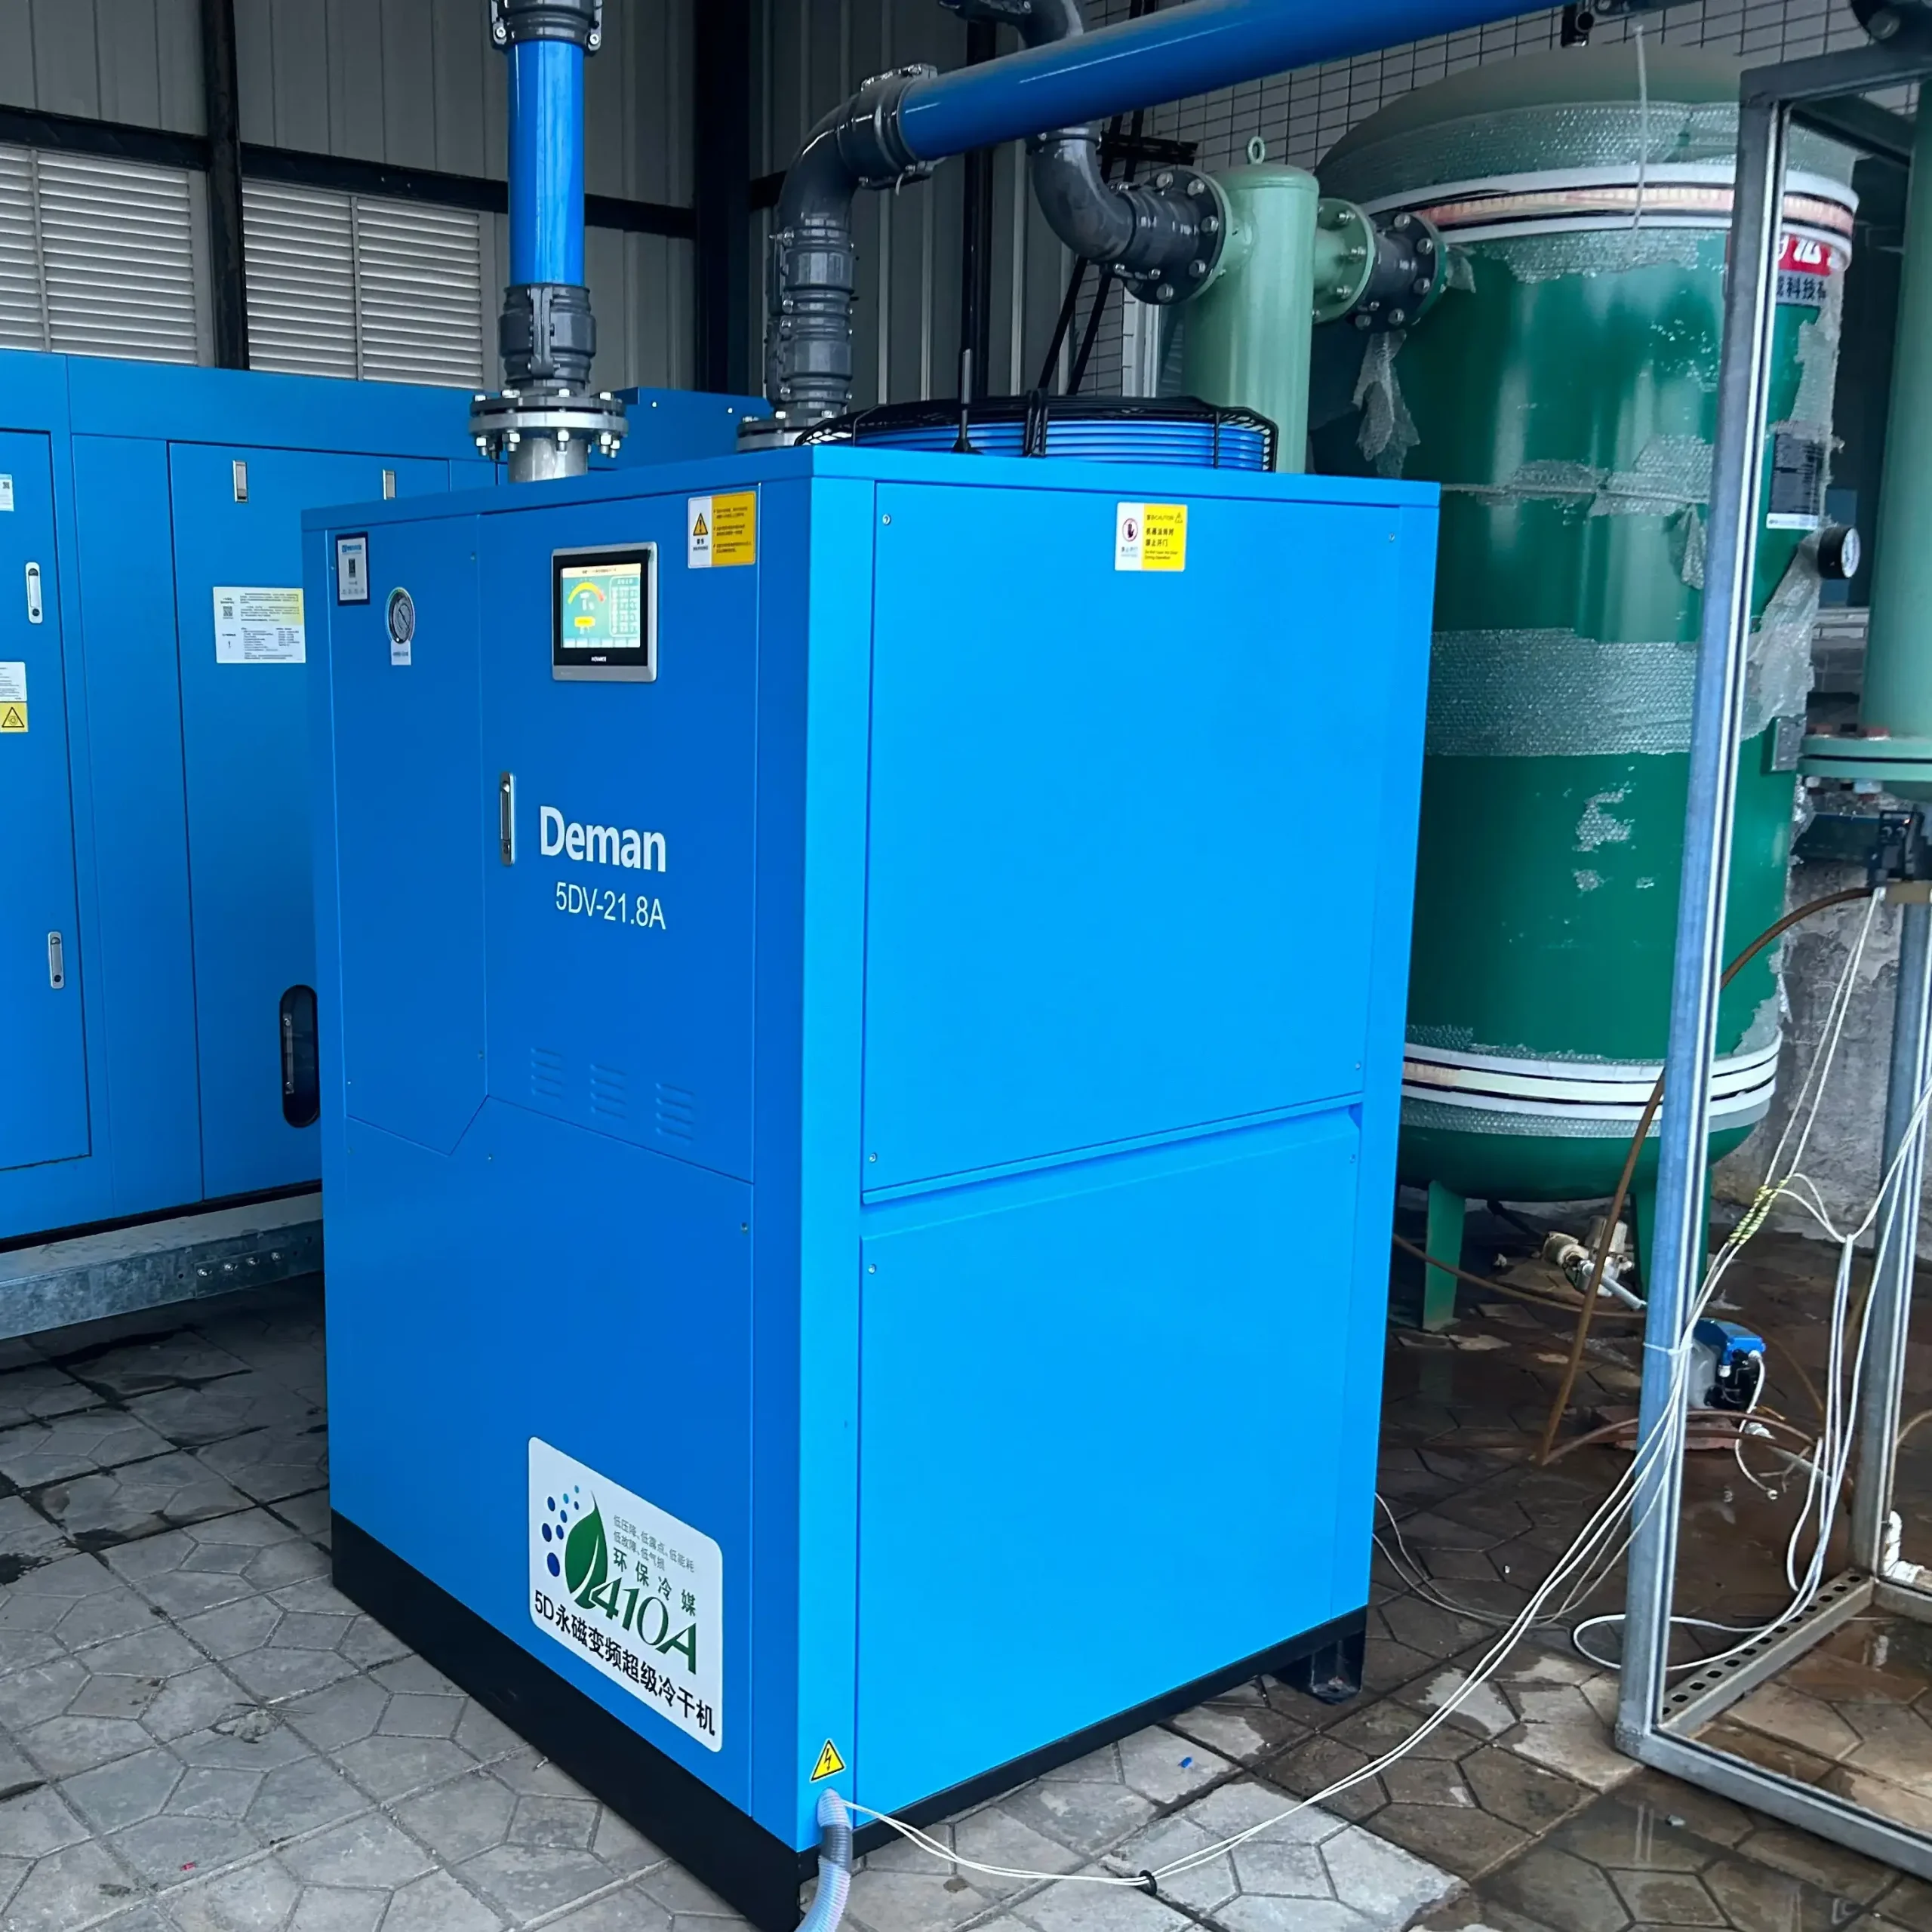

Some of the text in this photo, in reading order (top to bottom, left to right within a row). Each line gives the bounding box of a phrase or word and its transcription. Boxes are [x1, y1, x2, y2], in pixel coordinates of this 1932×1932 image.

[540, 805, 666, 872] Deman
[555, 881, 666, 930] 5DV-21.8A
[613, 1546, 696, 1617] 环保冷媒
[534, 1589, 715, 1737] 5D永磁变频超级冷干机
